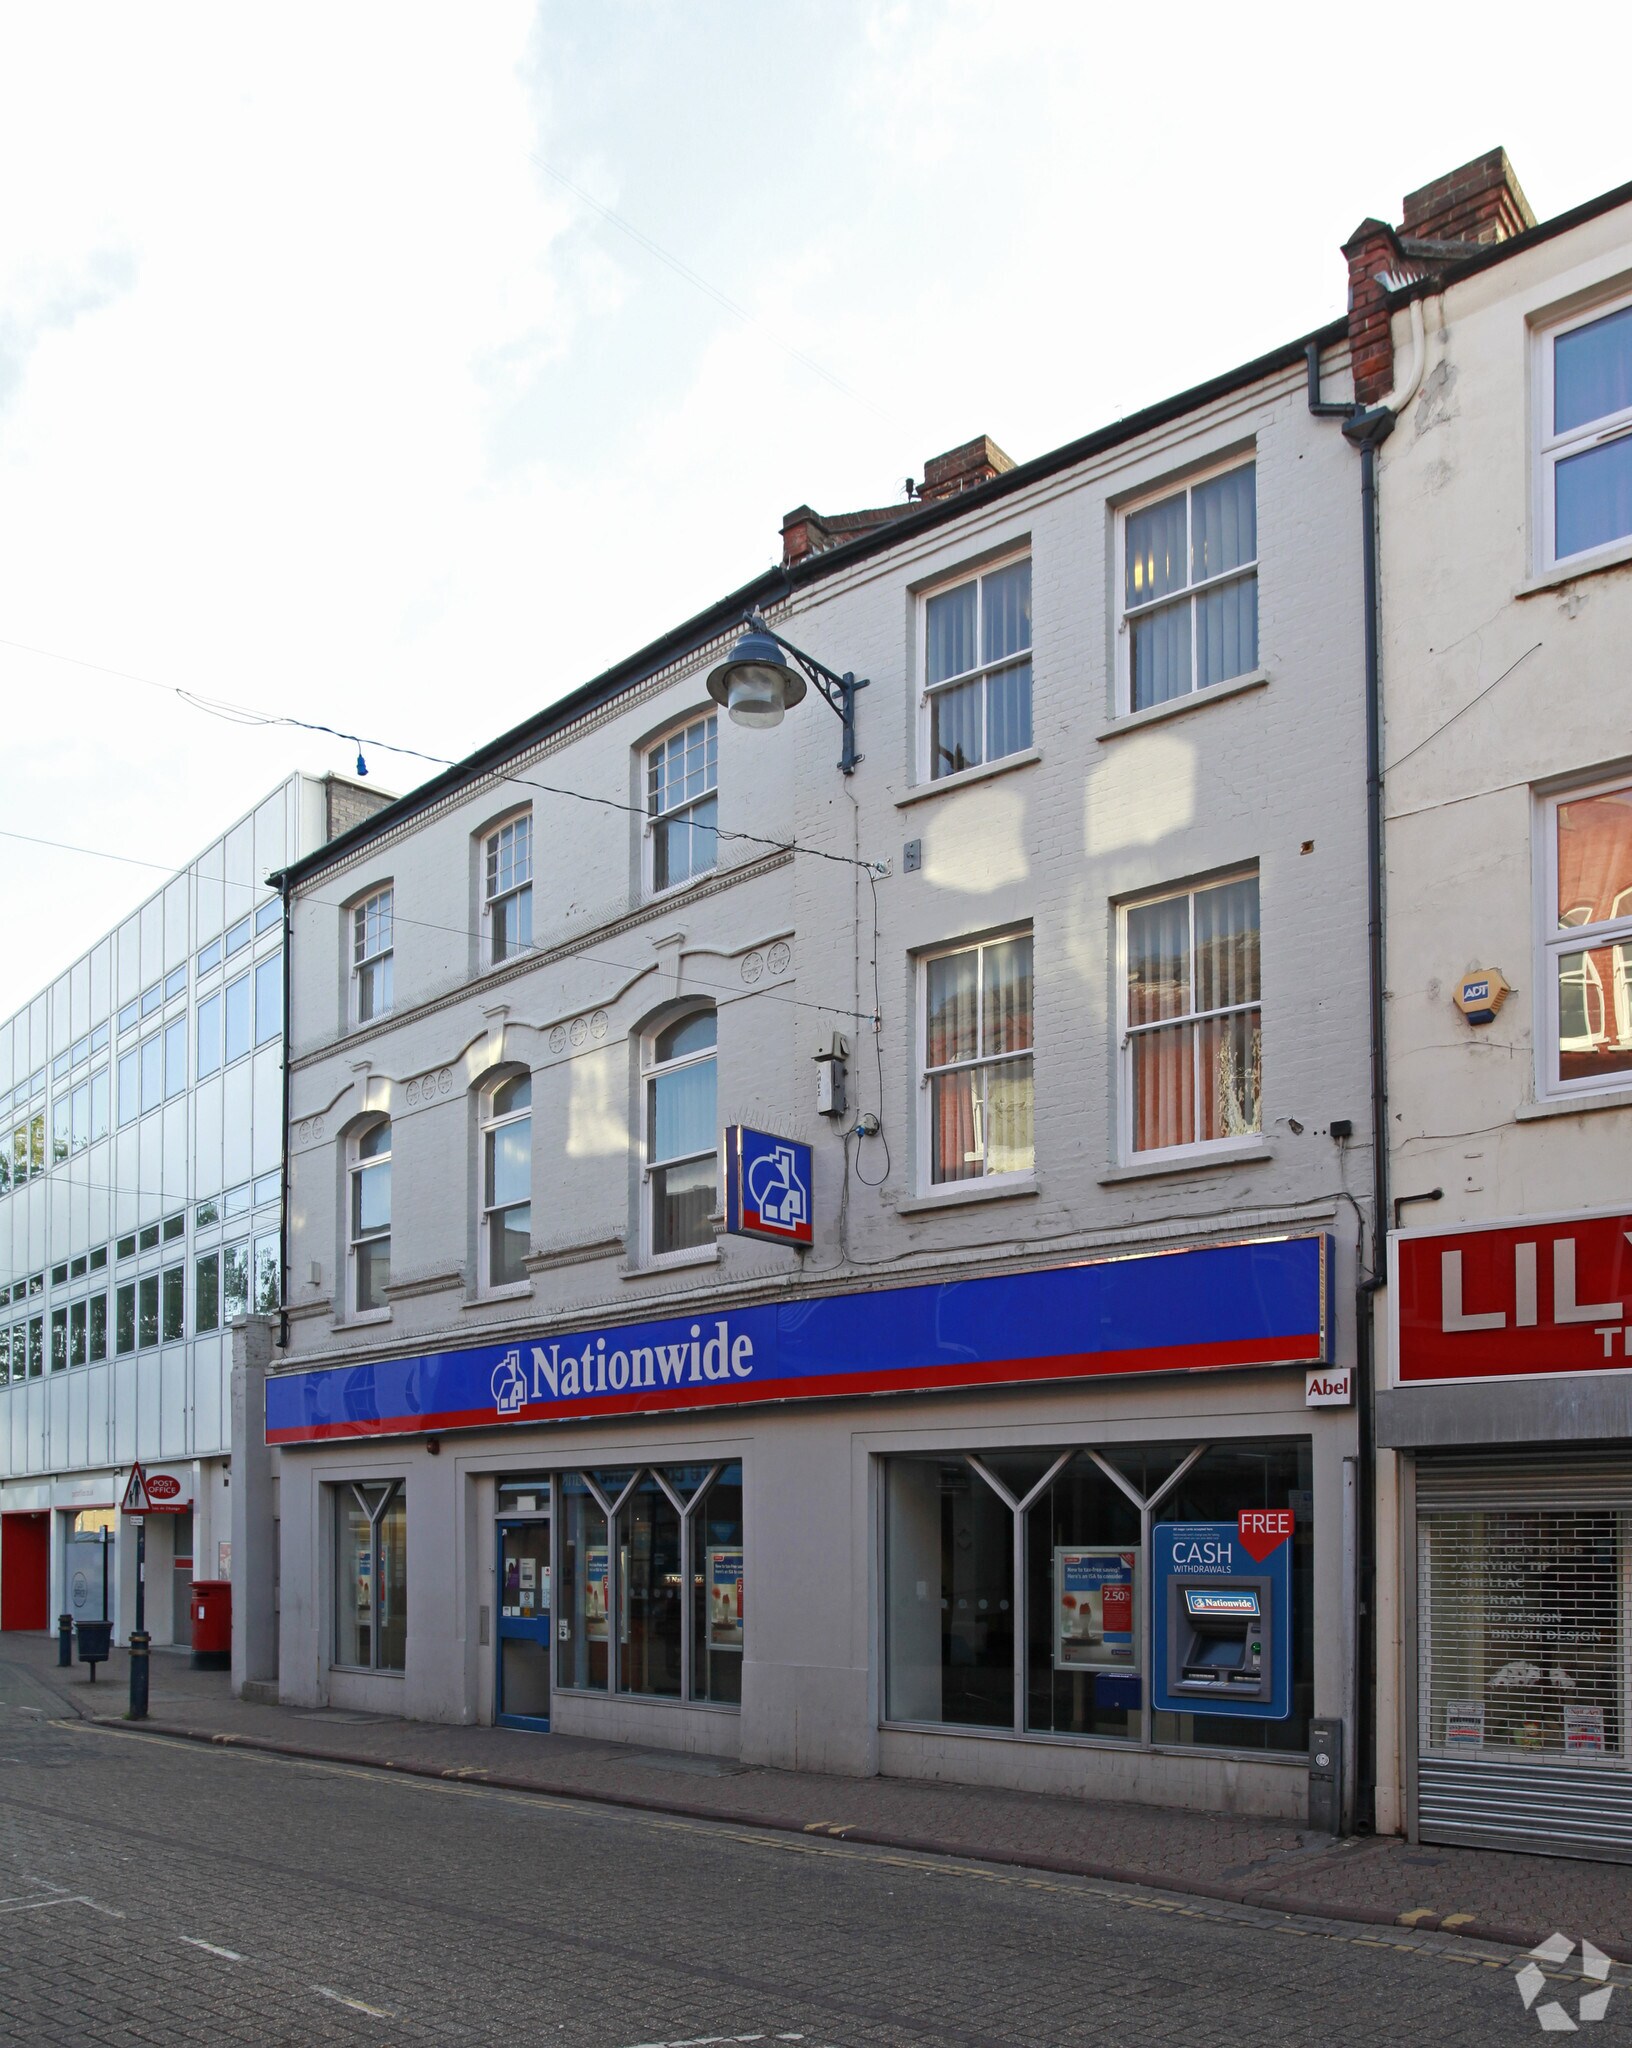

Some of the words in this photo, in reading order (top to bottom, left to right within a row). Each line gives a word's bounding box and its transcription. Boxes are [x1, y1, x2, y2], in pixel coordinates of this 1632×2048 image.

[1464, 985, 1488, 999] ADT
[1442, 1231, 1632, 1333] LIL
[531, 1320, 754, 1397] Nationwide
[1308, 1377, 1348, 1396] Abel
[148, 1486, 176, 1494] OFFICE
[1241, 1513, 1290, 1534] FREE
[1172, 1542, 1232, 1564] CASH
[1460, 1544, 1497, 1554] NEXT
[1504, 1544, 1533, 1554] GEN
[1540, 1545, 1584, 1554] NAILS
[1173, 1565, 1232, 1574] WITHDRAWALS
[1460, 1561, 1523, 1571] ACRYLIC
[1528, 1562, 1552, 1571] TIP
[1460, 1578, 1525, 1588] SHELLAC
[1205, 1599, 1252, 1608] Nationwide
[1460, 1595, 1527, 1605] OVERLAY
[1460, 1611, 1502, 1622] HAND
[1507, 1612, 1562, 1624] DESIGN
[1491, 1629, 1541, 1641] BRUSH
[1546, 1631, 1602, 1642] DESIGN
